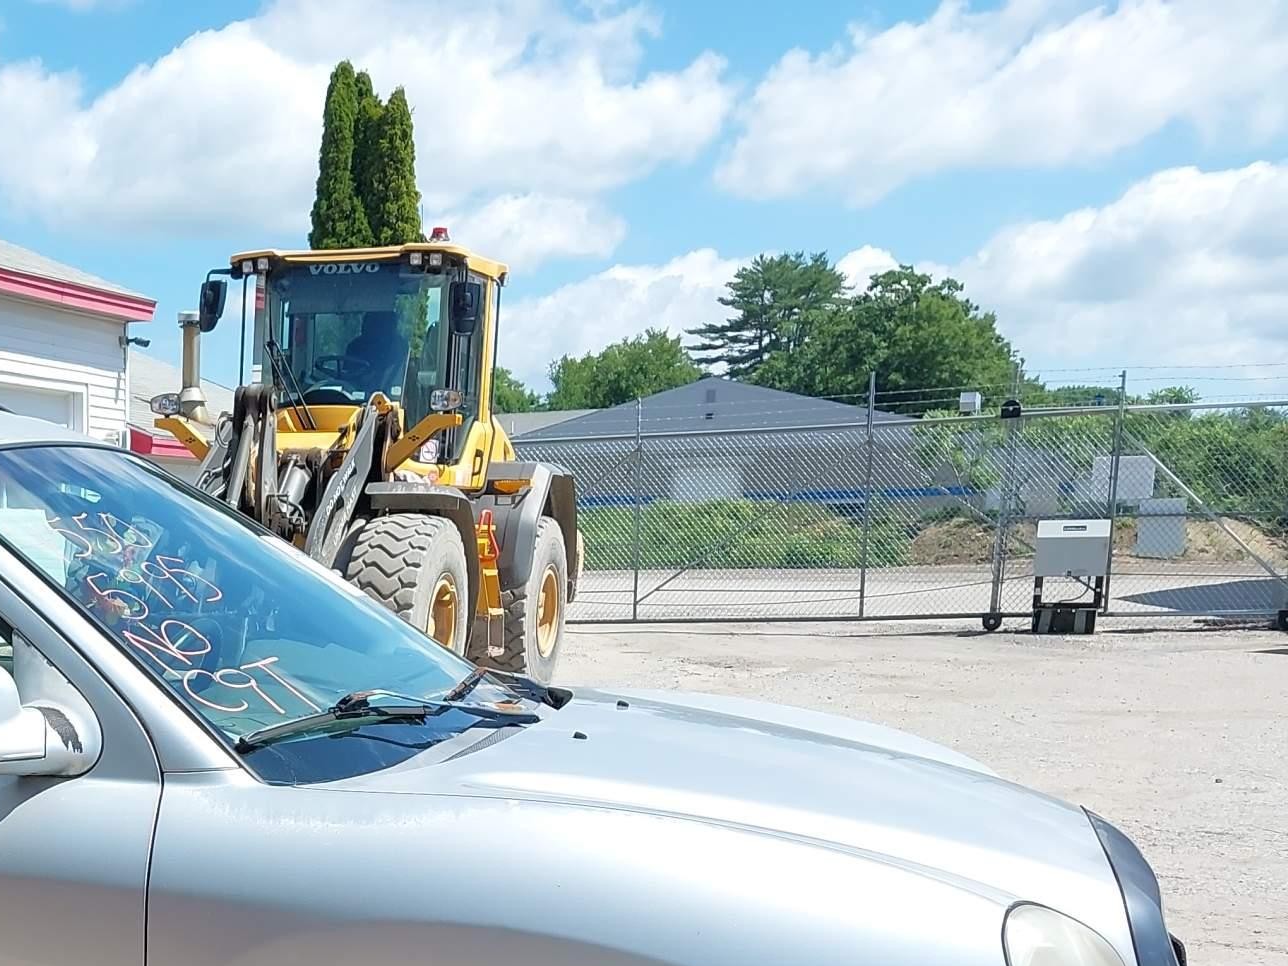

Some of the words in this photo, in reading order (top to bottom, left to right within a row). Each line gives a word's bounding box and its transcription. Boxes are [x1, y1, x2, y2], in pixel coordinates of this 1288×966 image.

[309, 263, 380, 275] VOLVO
[87, 555, 223, 620] 5995
[123, 620, 212, 678] NO
